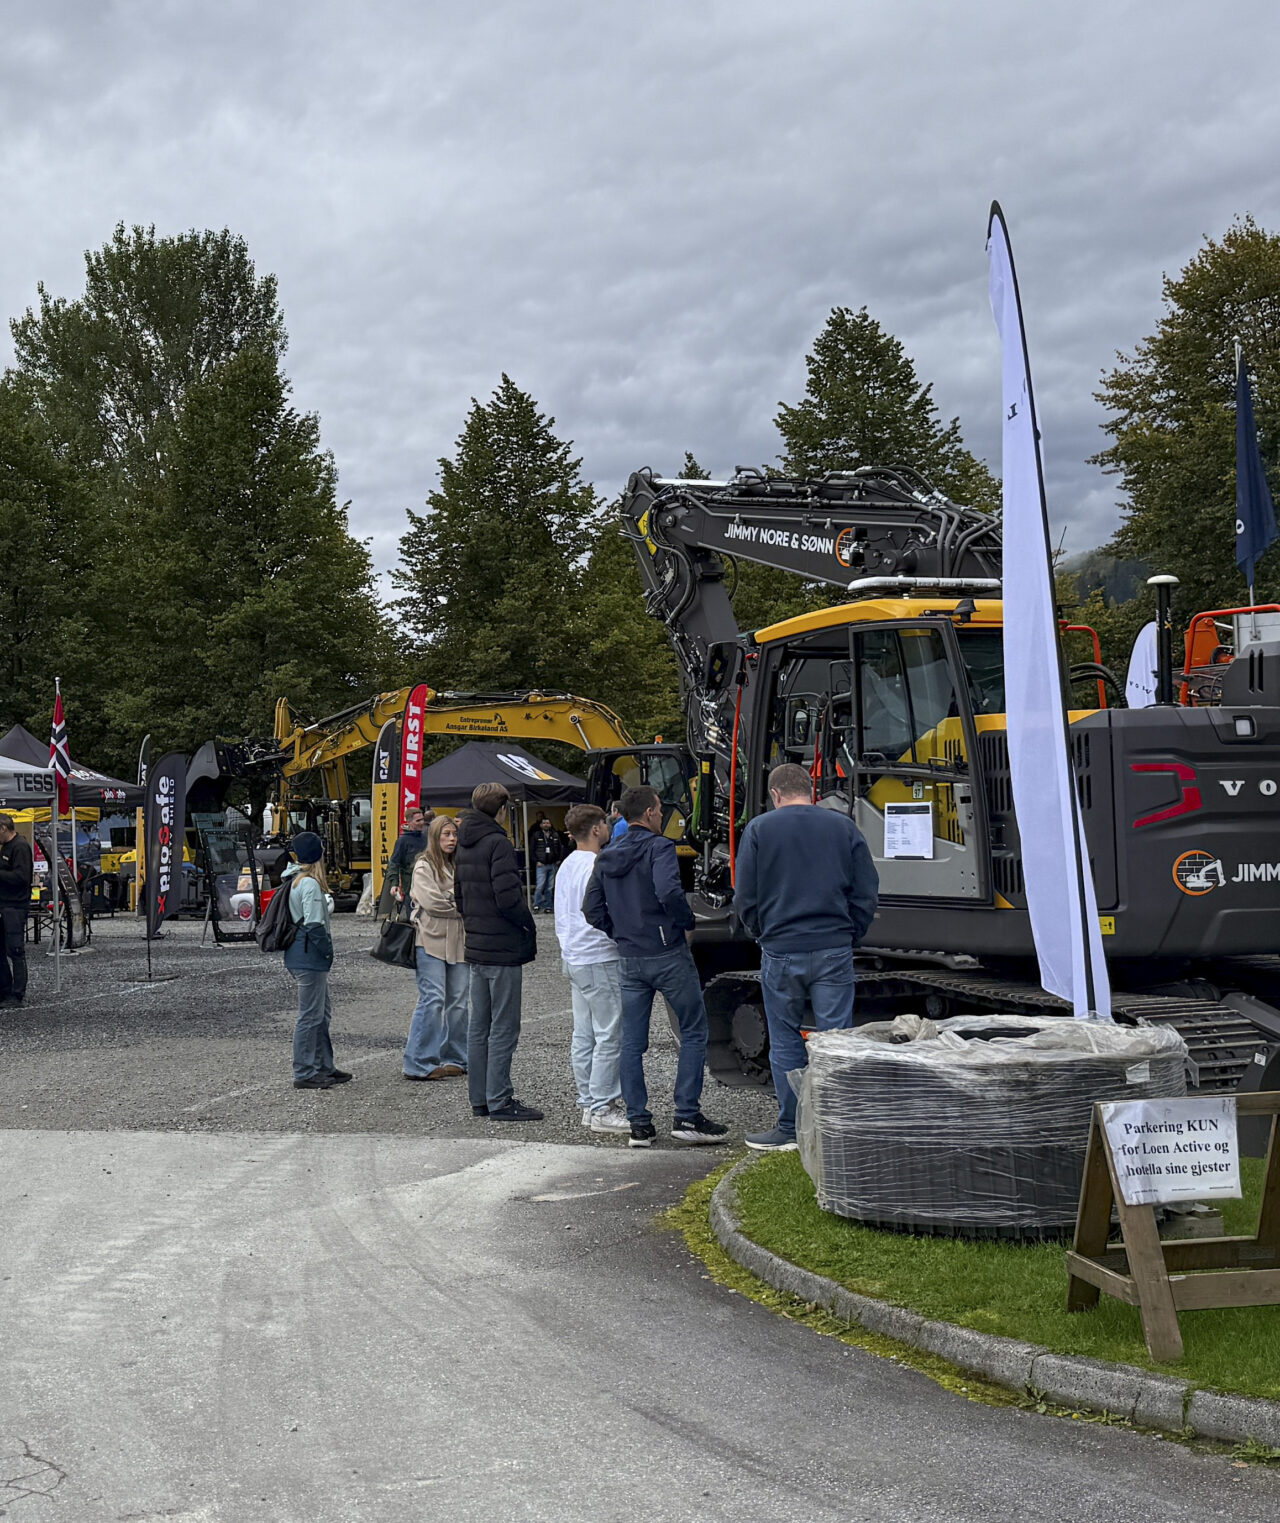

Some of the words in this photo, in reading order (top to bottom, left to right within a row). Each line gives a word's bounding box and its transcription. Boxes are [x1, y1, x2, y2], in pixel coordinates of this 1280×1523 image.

[724, 523, 758, 541] JIMMY
[759, 529, 790, 547] NORE
[790, 536, 799, 549] &
[801, 534, 834, 554] SØNN
[405, 701, 421, 777] FIRST
[379, 749, 390, 780] CAT
[13, 772, 54, 793] TESS
[1124, 1121, 1184, 1135] Parkering
[1187, 1119, 1218, 1131] KUN
[1122, 1143, 1139, 1155] for
[1143, 1142, 1169, 1154] Loen
[1173, 1140, 1211, 1153] Active
[1214, 1142, 1229, 1153] og
[1126, 1164, 1162, 1176] hotella
[1165, 1162, 1188, 1174] sine
[1190, 1161, 1231, 1176] gjester
